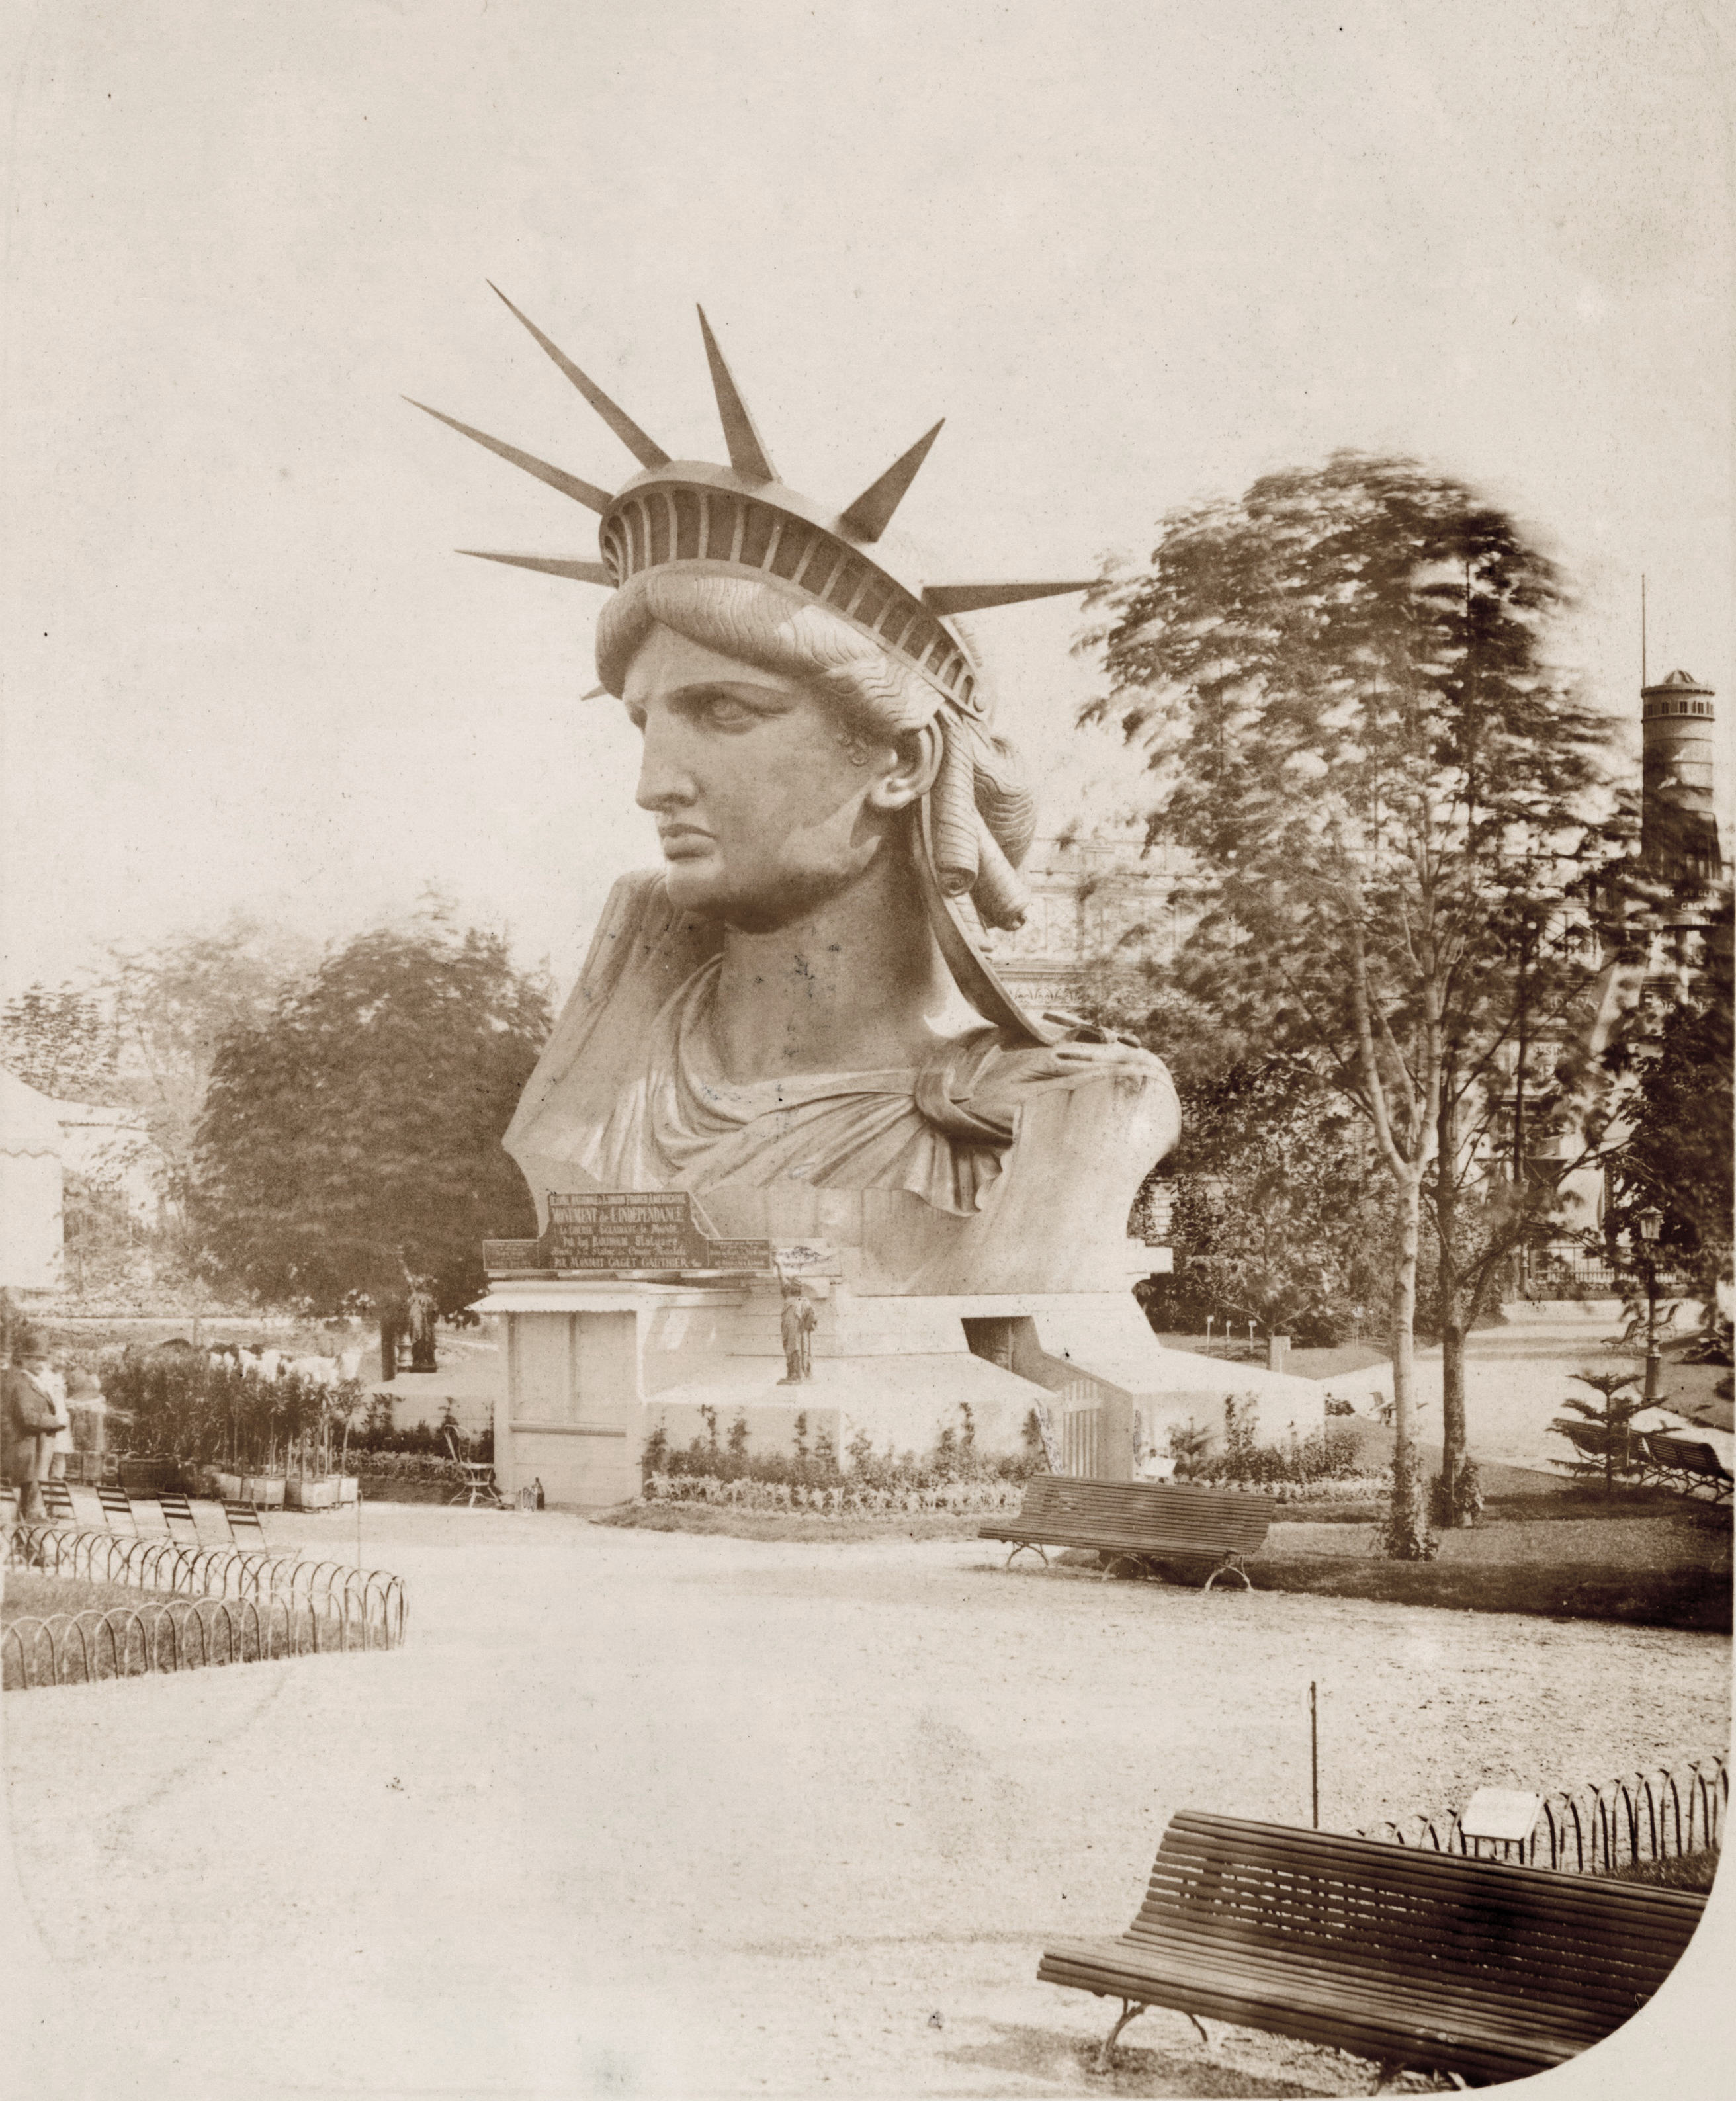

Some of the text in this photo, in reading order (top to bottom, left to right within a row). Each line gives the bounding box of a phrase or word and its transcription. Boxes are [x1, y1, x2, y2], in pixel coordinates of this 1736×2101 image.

[634, 1234, 677, 1247] Statuaire
[607, 1258, 636, 1268] GAGET
[640, 1258, 689, 1268] GAUTHIER
